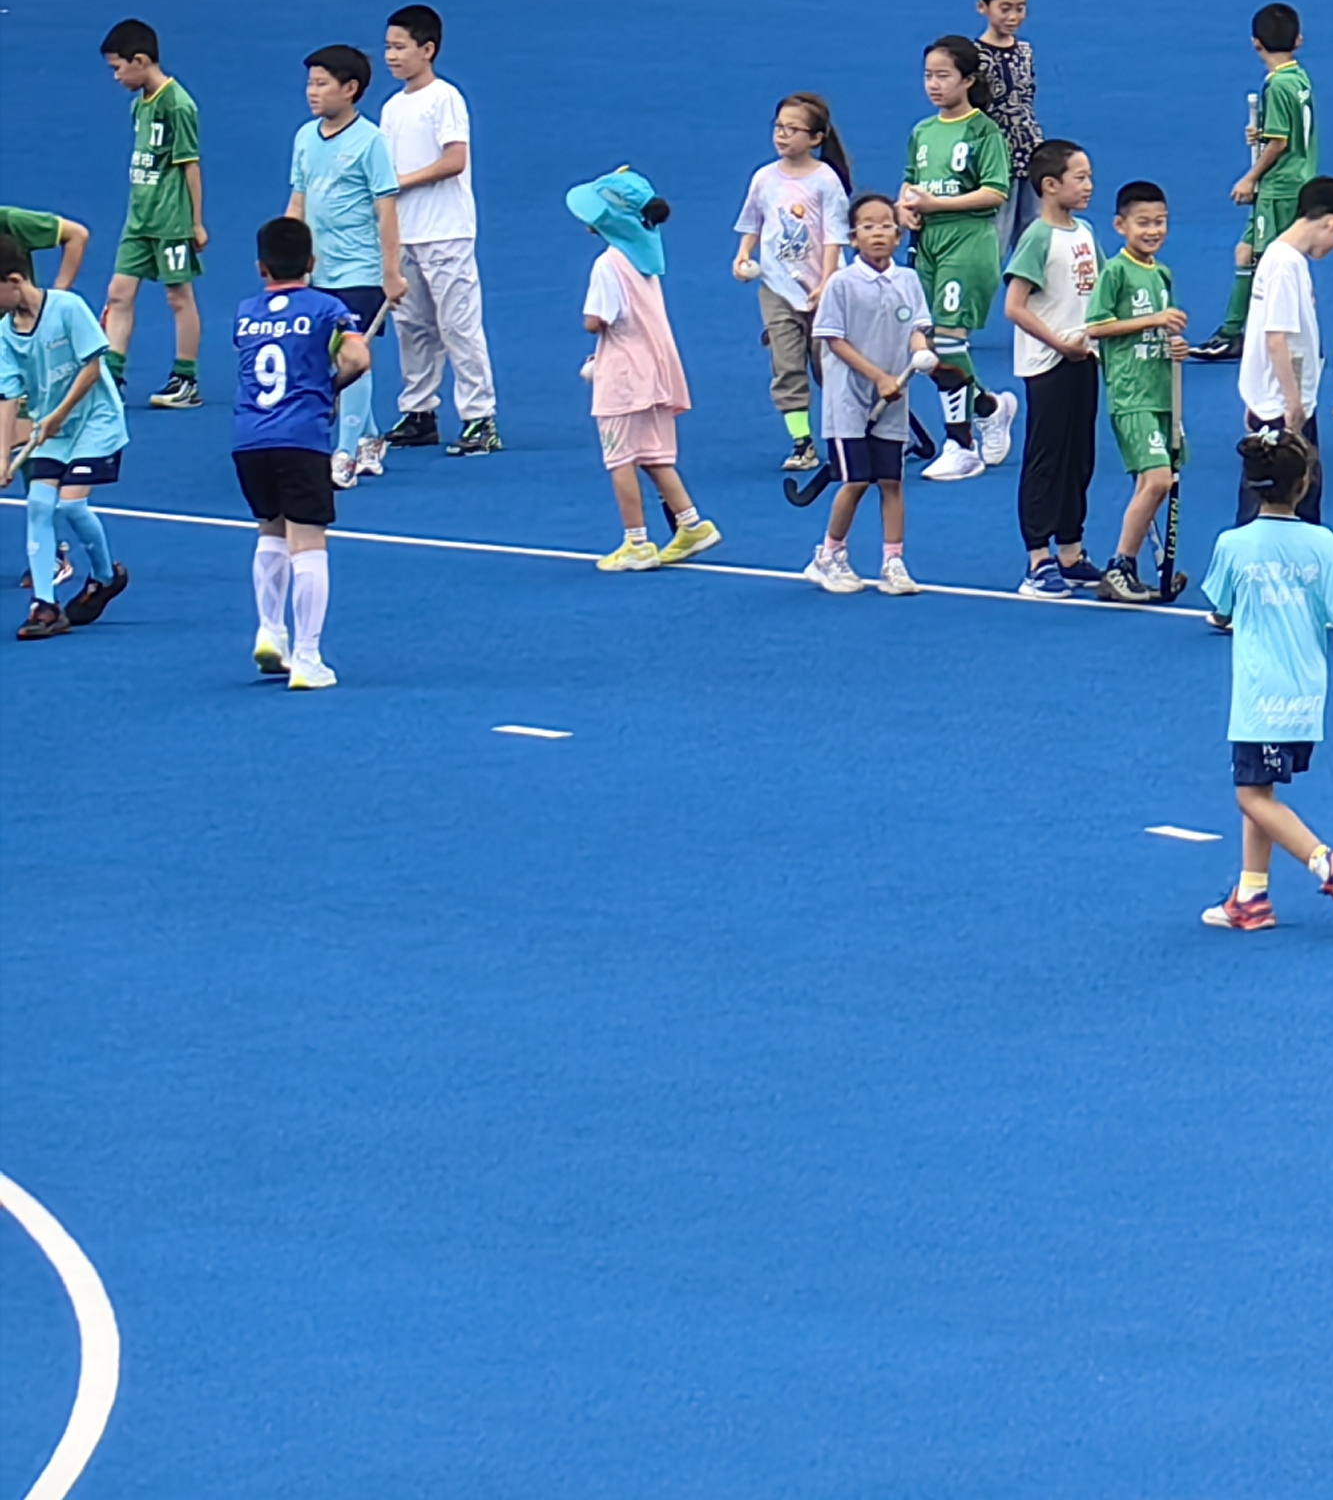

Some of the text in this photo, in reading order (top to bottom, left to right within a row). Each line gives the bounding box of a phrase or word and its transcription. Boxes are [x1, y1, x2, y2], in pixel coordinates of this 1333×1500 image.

[951, 142, 969, 172] 8
[164, 244, 187, 270] 17
[943, 280, 961, 312] 8
[236, 316, 311, 338] Zeng.Q
[254, 343, 287, 410] 9
